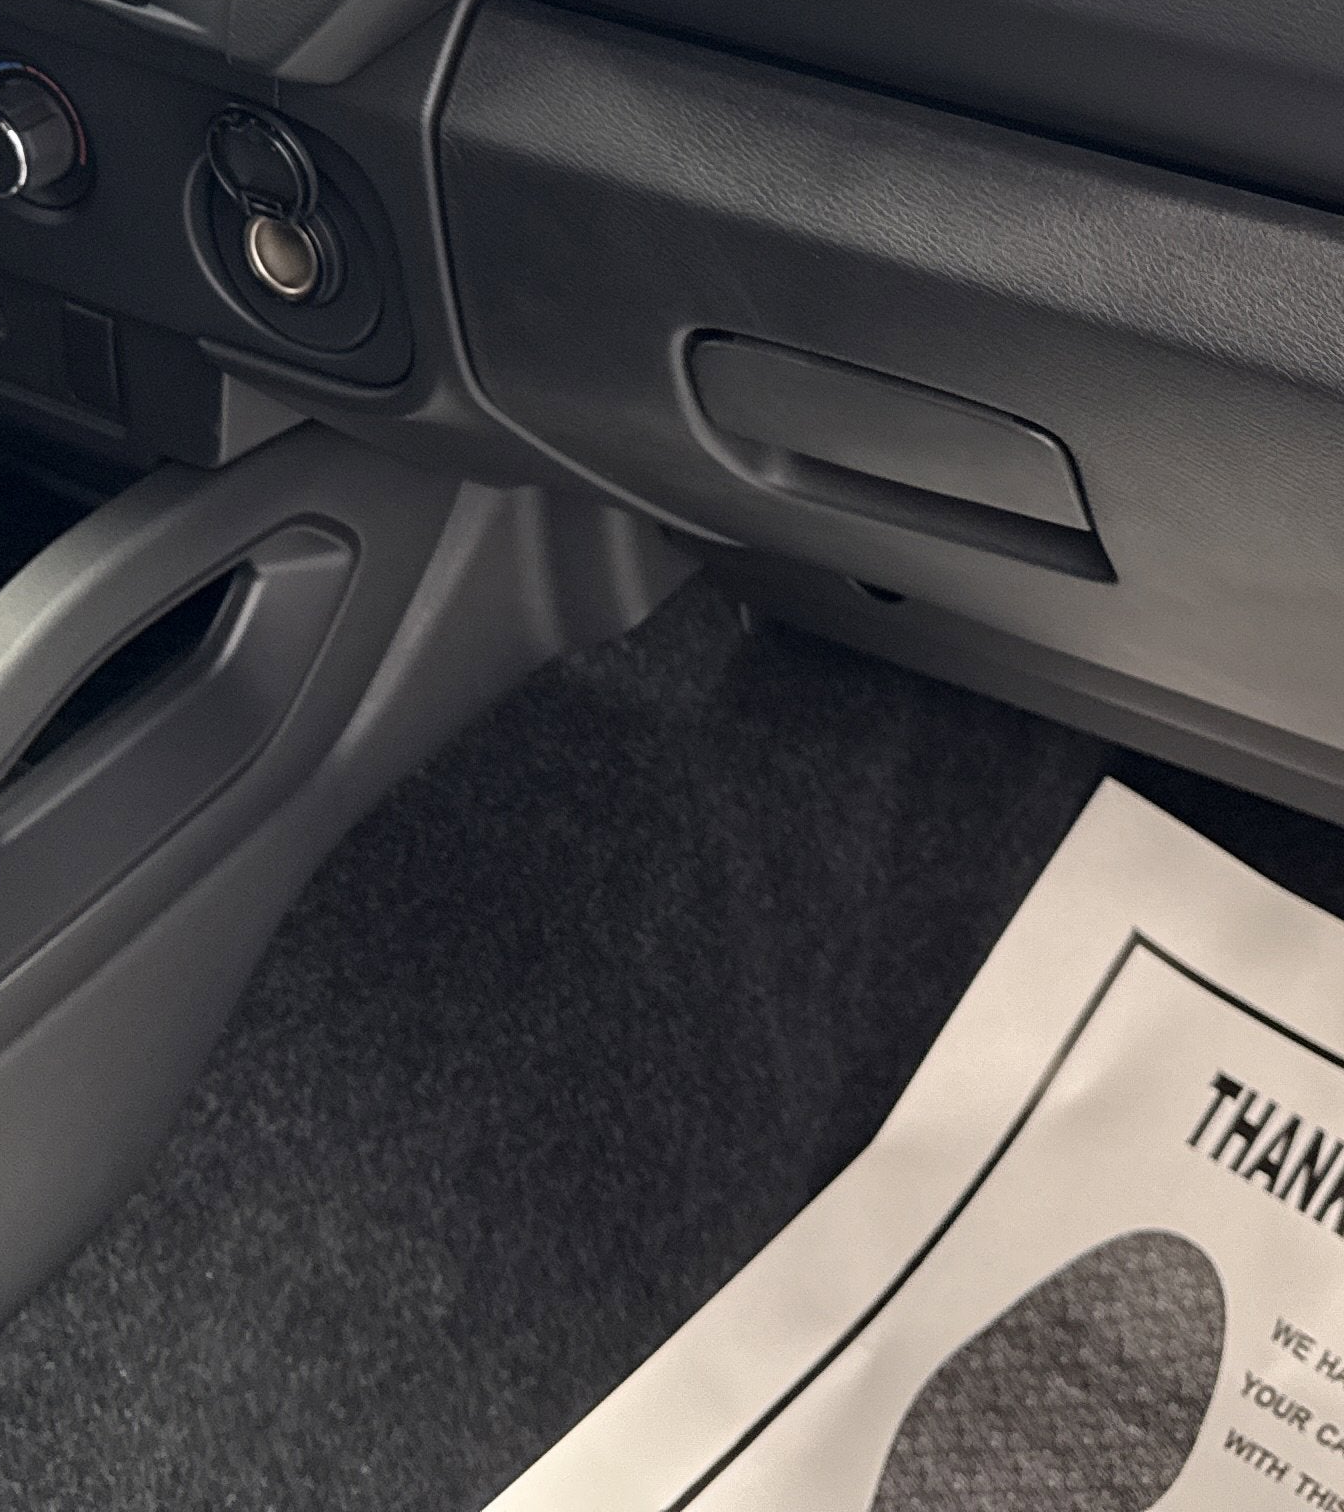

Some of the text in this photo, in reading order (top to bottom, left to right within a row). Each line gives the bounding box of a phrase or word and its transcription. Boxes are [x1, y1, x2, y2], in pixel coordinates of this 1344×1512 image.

[1270, 1316, 1316, 1362] WE
[1240, 1370, 1313, 1432] YOUR
[1224, 1427, 1292, 1484] WITH
